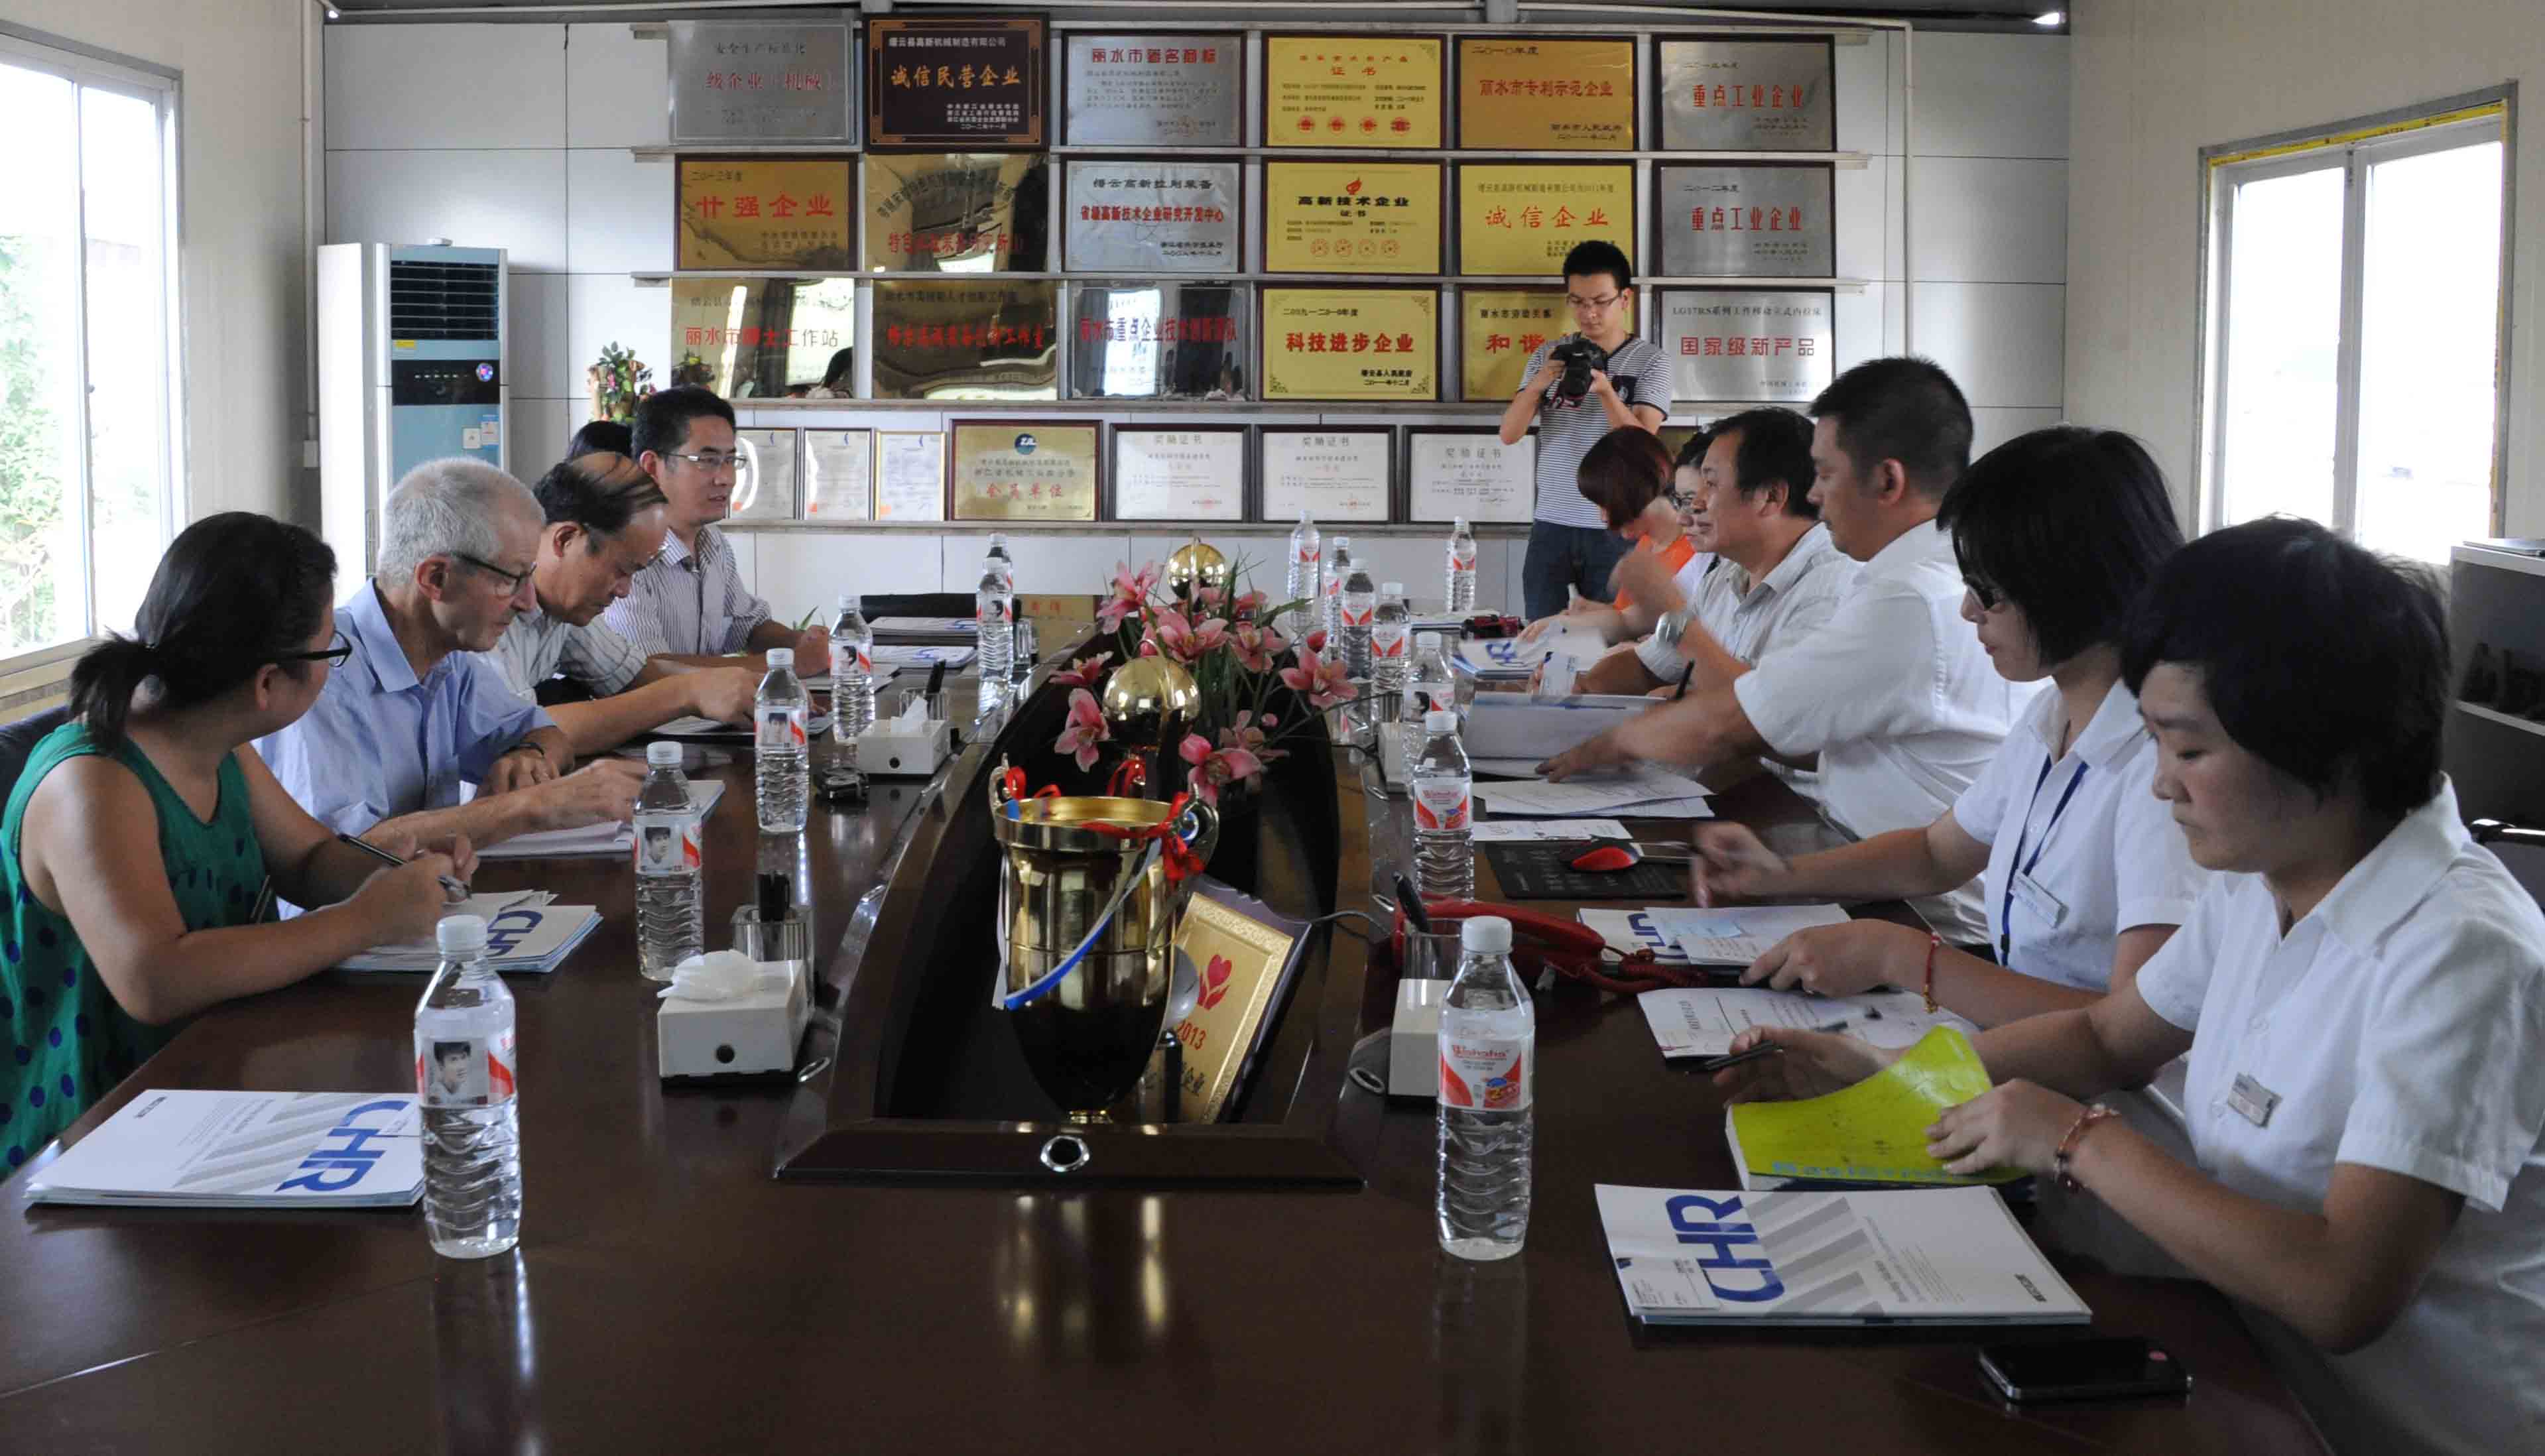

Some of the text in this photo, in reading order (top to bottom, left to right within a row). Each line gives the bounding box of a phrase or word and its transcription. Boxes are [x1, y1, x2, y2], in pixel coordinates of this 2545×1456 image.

[891, 64, 1021, 90] 诚信民营企业
[1479, 80, 1614, 97] 丽水市专利示范企业
[1692, 84, 1805, 108] 重点工业企业
[1297, 196, 1410, 207] 高新技术企业
[1484, 206, 1611, 229] 诚信企业
[1692, 206, 1802, 231] 重点工业企业
[1286, 332, 1414, 353] 科技进步企业
[1680, 336, 1815, 357] 国家级新产品
[275, 1100, 410, 1192] CHR
[1665, 1193, 1786, 1304] CHR
